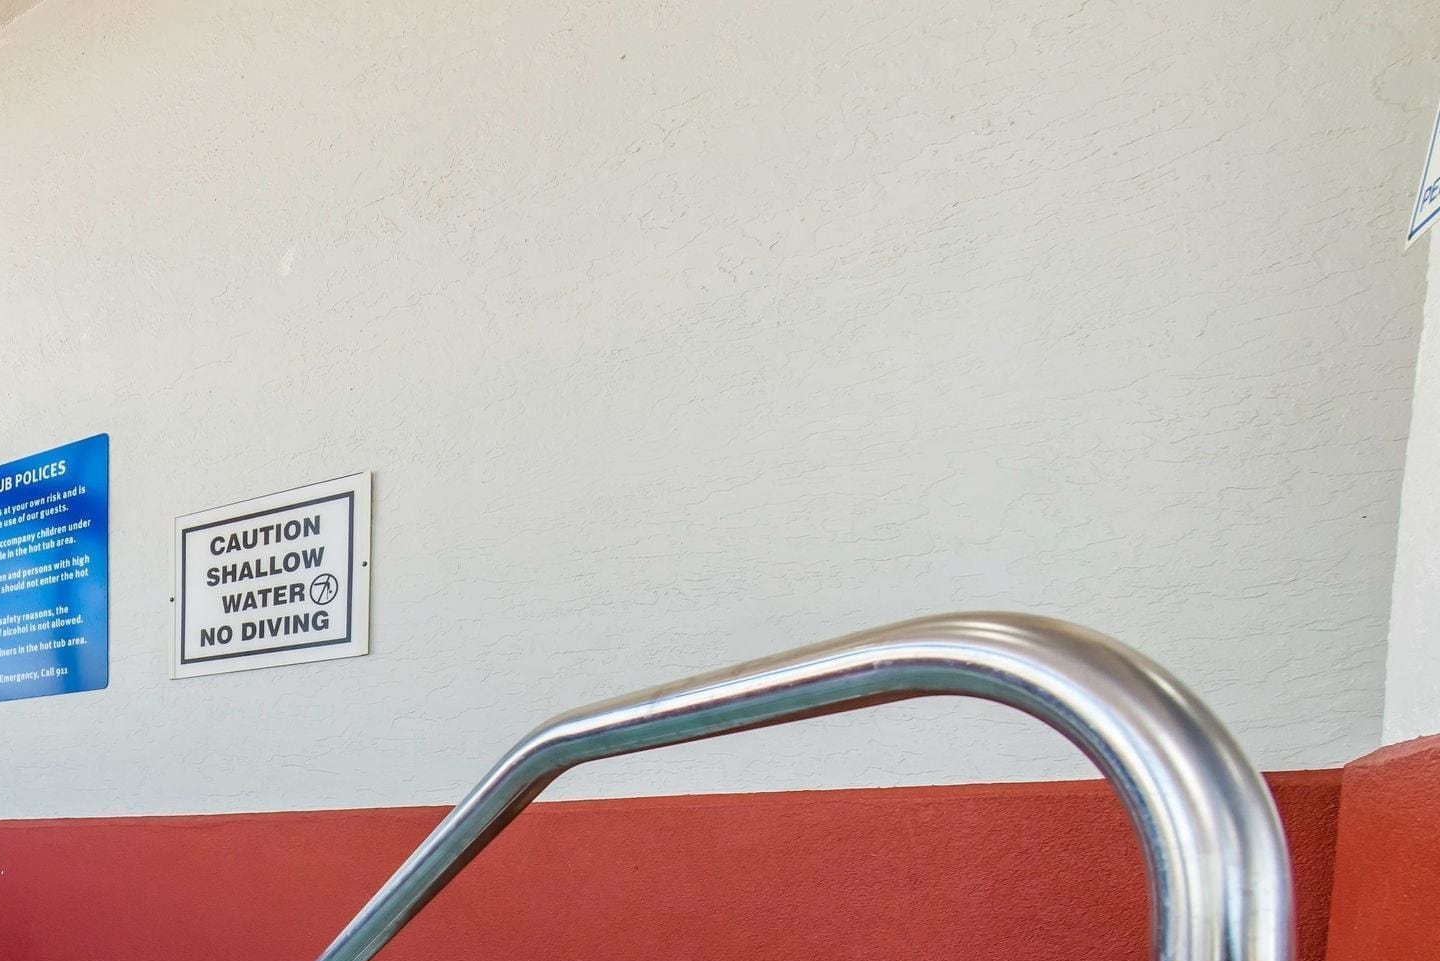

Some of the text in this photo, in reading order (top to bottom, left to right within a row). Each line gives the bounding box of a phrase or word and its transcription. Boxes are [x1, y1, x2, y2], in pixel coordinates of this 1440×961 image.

[16, 460, 65, 487] POLICES
[4, 506, 11, 515] at
[12, 502, 28, 514] your
[30, 498, 45, 507] own
[47, 492, 61, 503] risk
[63, 487, 76, 498] and
[79, 485, 85, 494] is
[4, 517, 16, 527] use
[18, 513, 25, 523] of
[27, 512, 39, 520] our
[40, 504, 68, 519] guests.
[37, 526, 66, 538] children
[69, 519, 91, 531] under
[210, 515, 320, 556] CAUTION
[8, 550, 14, 558] in
[16, 547, 27, 556] the
[29, 543, 41, 553] hot
[43, 539, 54, 549] tub
[57, 537, 76, 547] area.
[8, 569, 20, 580] and
[23, 564, 52, 578] persons
[54, 559, 70, 570] with
[72, 554, 90, 566] high
[206, 547, 325, 586] SHALLOW
[1, 580, 25, 593] should
[27, 579, 38, 588] not
[40, 575, 59, 585] enter
[61, 572, 73, 581] the
[75, 568, 88, 578] hot
[222, 583, 305, 614] WATER
[0, 615, 20, 625] safety
[56, 606, 68, 615] the
[3, 624, 28, 636] alcohol
[30, 624, 36, 632] is
[38, 621, 49, 630] not
[51, 614, 83, 628] allowed.
[200, 610, 329, 647] NO DIVING
[18, 645, 24, 654] in
[27, 644, 38, 653] the
[40, 642, 52, 650] hot
[54, 639, 65, 648] tub
[68, 637, 87, 646] area.
[41, 667, 54, 677] Call
[56, 668, 68, 677] 911
